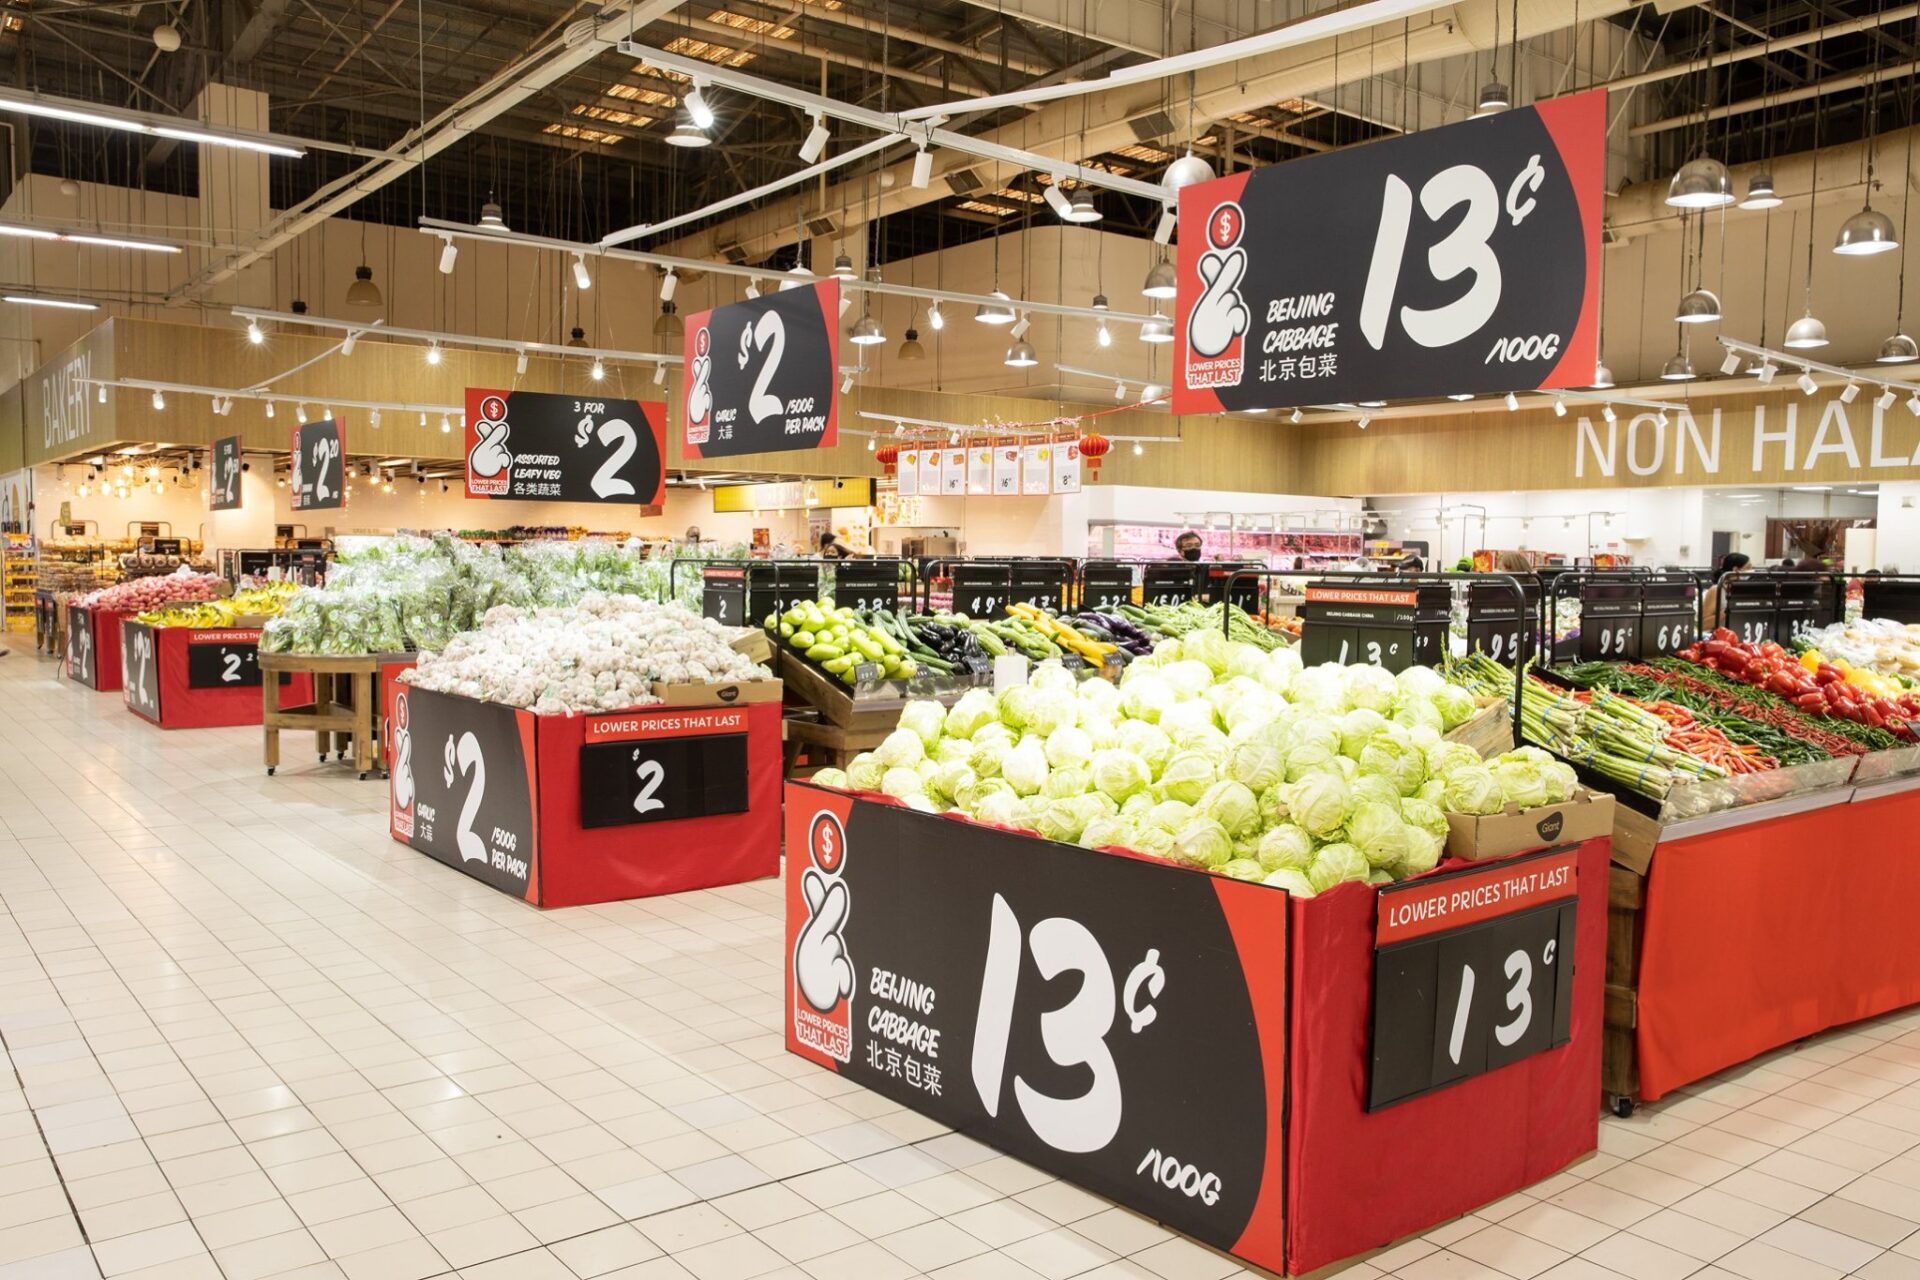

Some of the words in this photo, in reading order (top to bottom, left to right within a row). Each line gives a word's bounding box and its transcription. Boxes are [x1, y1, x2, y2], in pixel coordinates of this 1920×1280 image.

[1266, 292, 1335, 323] BEIJING
[1263, 323, 1339, 354] CABBAGE
[1189, 361, 1214, 372] LOWER
[1215, 359, 1241, 370] PRICES
[1189, 371, 1213, 386] THAT
[1215, 369, 1240, 383] LAST
[1259, 353, 1338, 382] 北京包菜
[43, 349, 91, 449] BAKERY
[574, 401, 581, 413] 3
[584, 402, 605, 414] FOR
[785, 397, 815, 415] /500G
[785, 418, 801, 435] PER
[802, 416, 826, 433] PACK
[1574, 407, 1722, 479] NON
[1752, 397, 1920, 472] HAL
[514, 454, 560, 466] ASSORTED
[514, 469, 542, 479] LEAFY
[543, 469, 562, 480] VEG
[513, 482, 562, 496] 各类蔬菜
[1312, 590, 1340, 600] LOWER
[1341, 591, 1367, 601] PRICES
[1368, 593, 1389, 602] THAT
[1390, 594, 1410, 603] LAST
[194, 633, 222, 641] LOWER
[223, 632, 248, 640] PRICES
[593, 720, 639, 734] LOWER
[641, 718, 681, 731] PRICES
[683, 716, 713, 728] THAT
[715, 714, 741, 727] LAST
[1541, 821, 1561, 834] Giant
[492, 848, 506, 871] PER
[506, 856, 527, 880] PACK
[1389, 896, 1447, 928] LOWER
[1451, 884, 1500, 913] PRICES
[1503, 874, 1537, 899] THAT
[1539, 866, 1570, 890] LAST
[869, 966, 936, 1016] BEIJING
[797, 1007, 822, 1029] LOWER
[821, 1019, 848, 1039] PRICES
[868, 1006, 940, 1058] CABBAGE
[798, 1022, 822, 1047] THAT
[822, 1034, 849, 1059] LAST
[866, 1039, 942, 1097] 北京包菜
